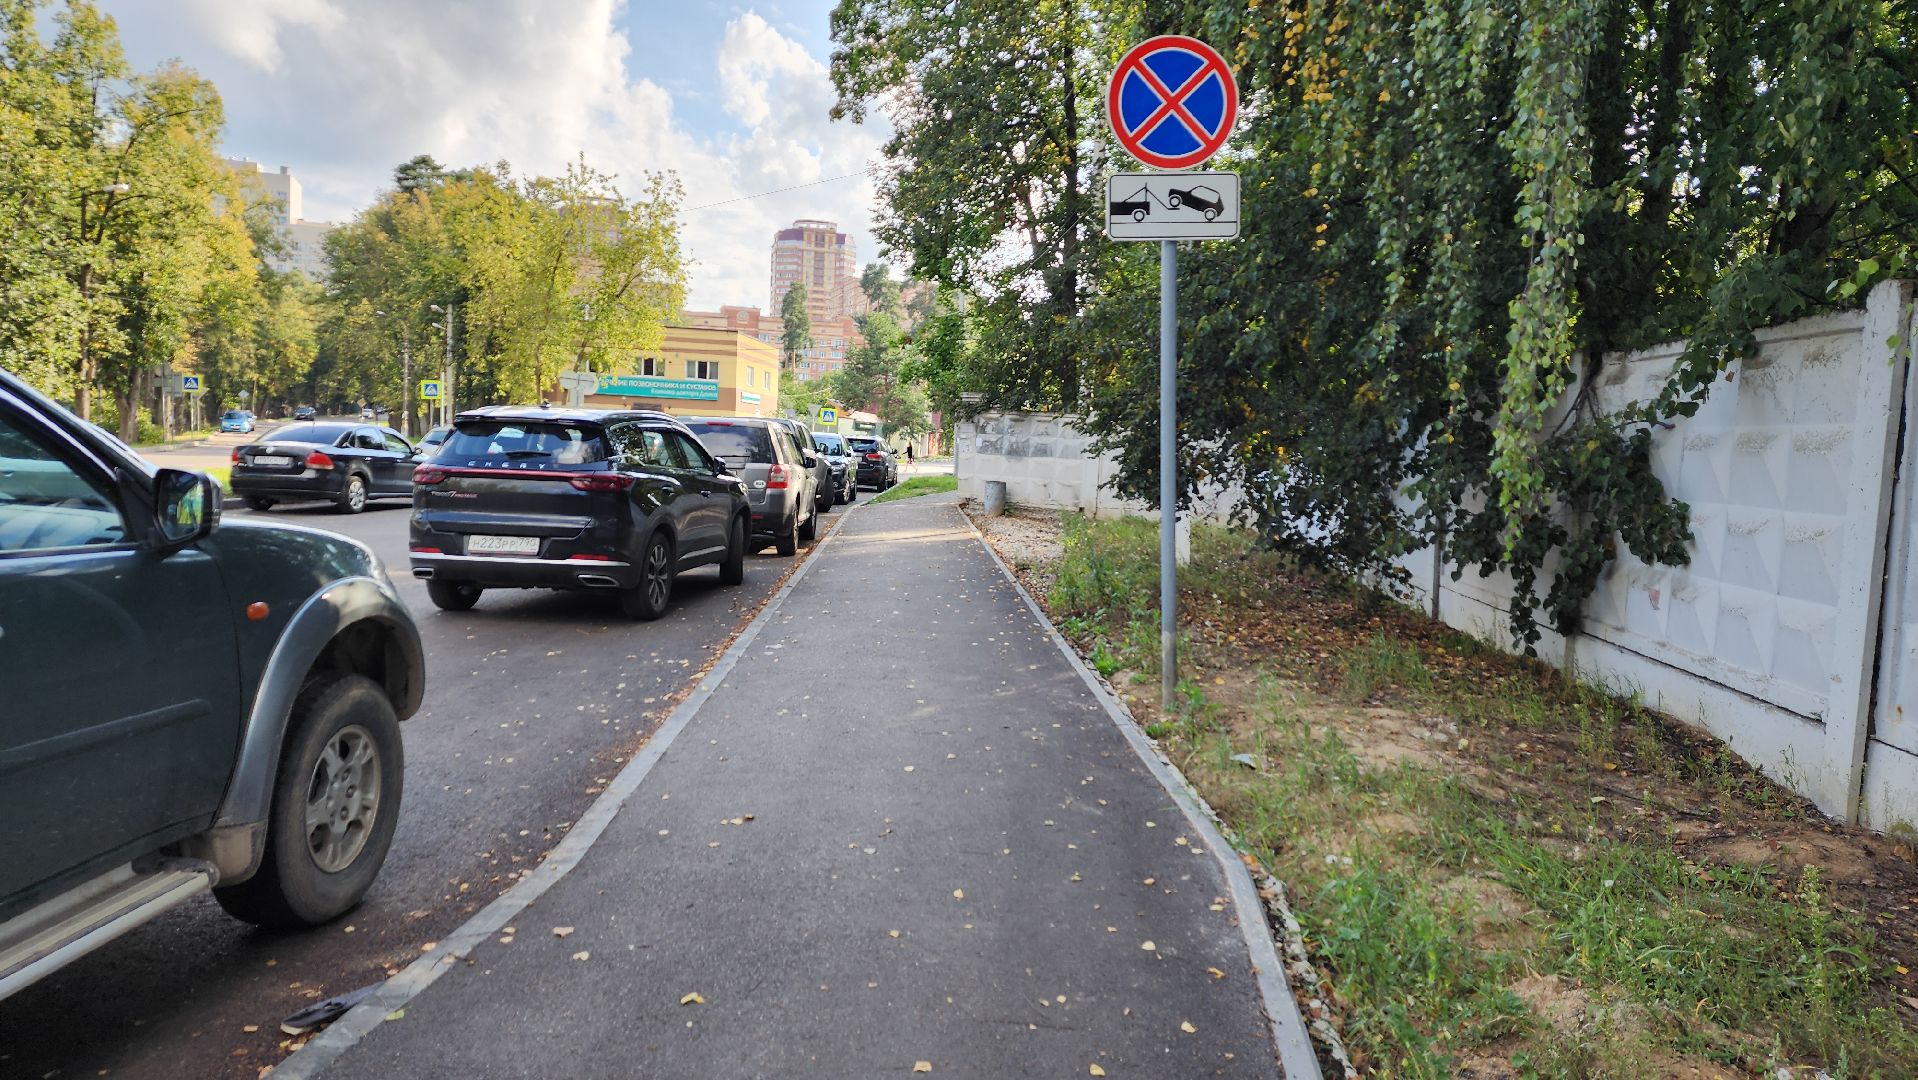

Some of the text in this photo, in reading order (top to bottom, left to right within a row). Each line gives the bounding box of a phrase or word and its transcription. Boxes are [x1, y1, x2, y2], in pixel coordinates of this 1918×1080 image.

[628, 380, 679, 389] ПОЗВОНОЧНИКА
[686, 383, 716, 391] СУСТАВОВ
[468, 461, 546, 469] CHERY
